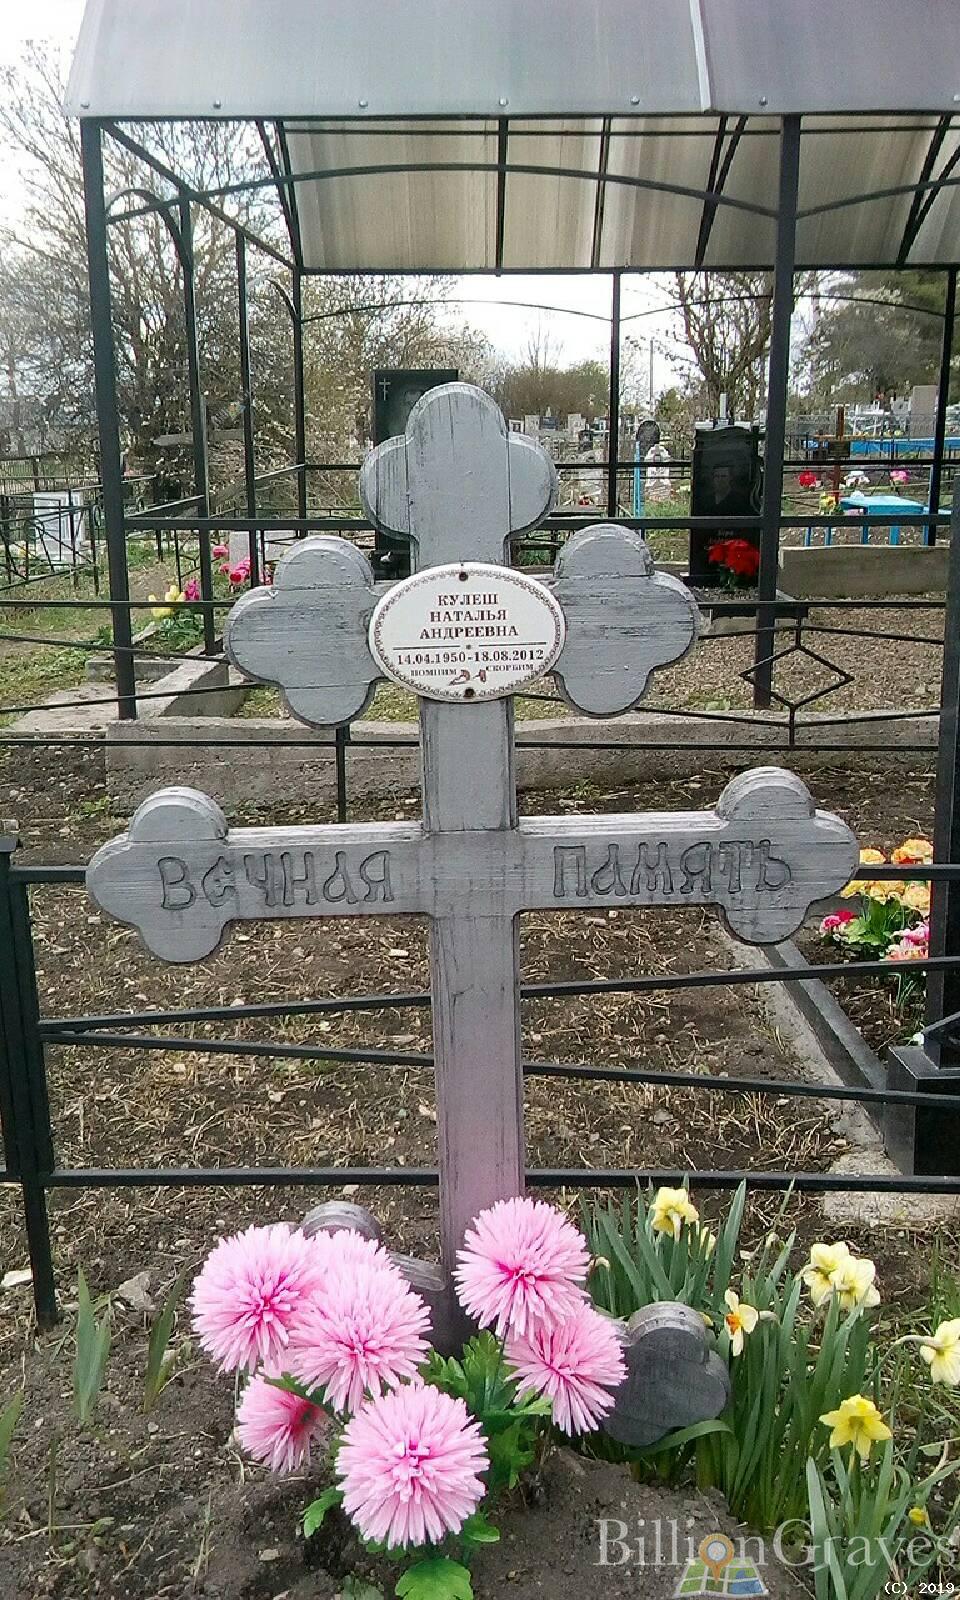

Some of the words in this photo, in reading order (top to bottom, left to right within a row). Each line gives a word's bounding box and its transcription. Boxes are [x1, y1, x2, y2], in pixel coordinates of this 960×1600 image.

[438, 593, 499, 606] КУЛЕШ
[430, 609, 508, 623] НАТАЛЬЯ
[419, 625, 519, 640] АНДРЕЕВНА
[410, 668, 458, 677] ПОМНИМ
[485, 663, 534, 672] СКОРБИМ
